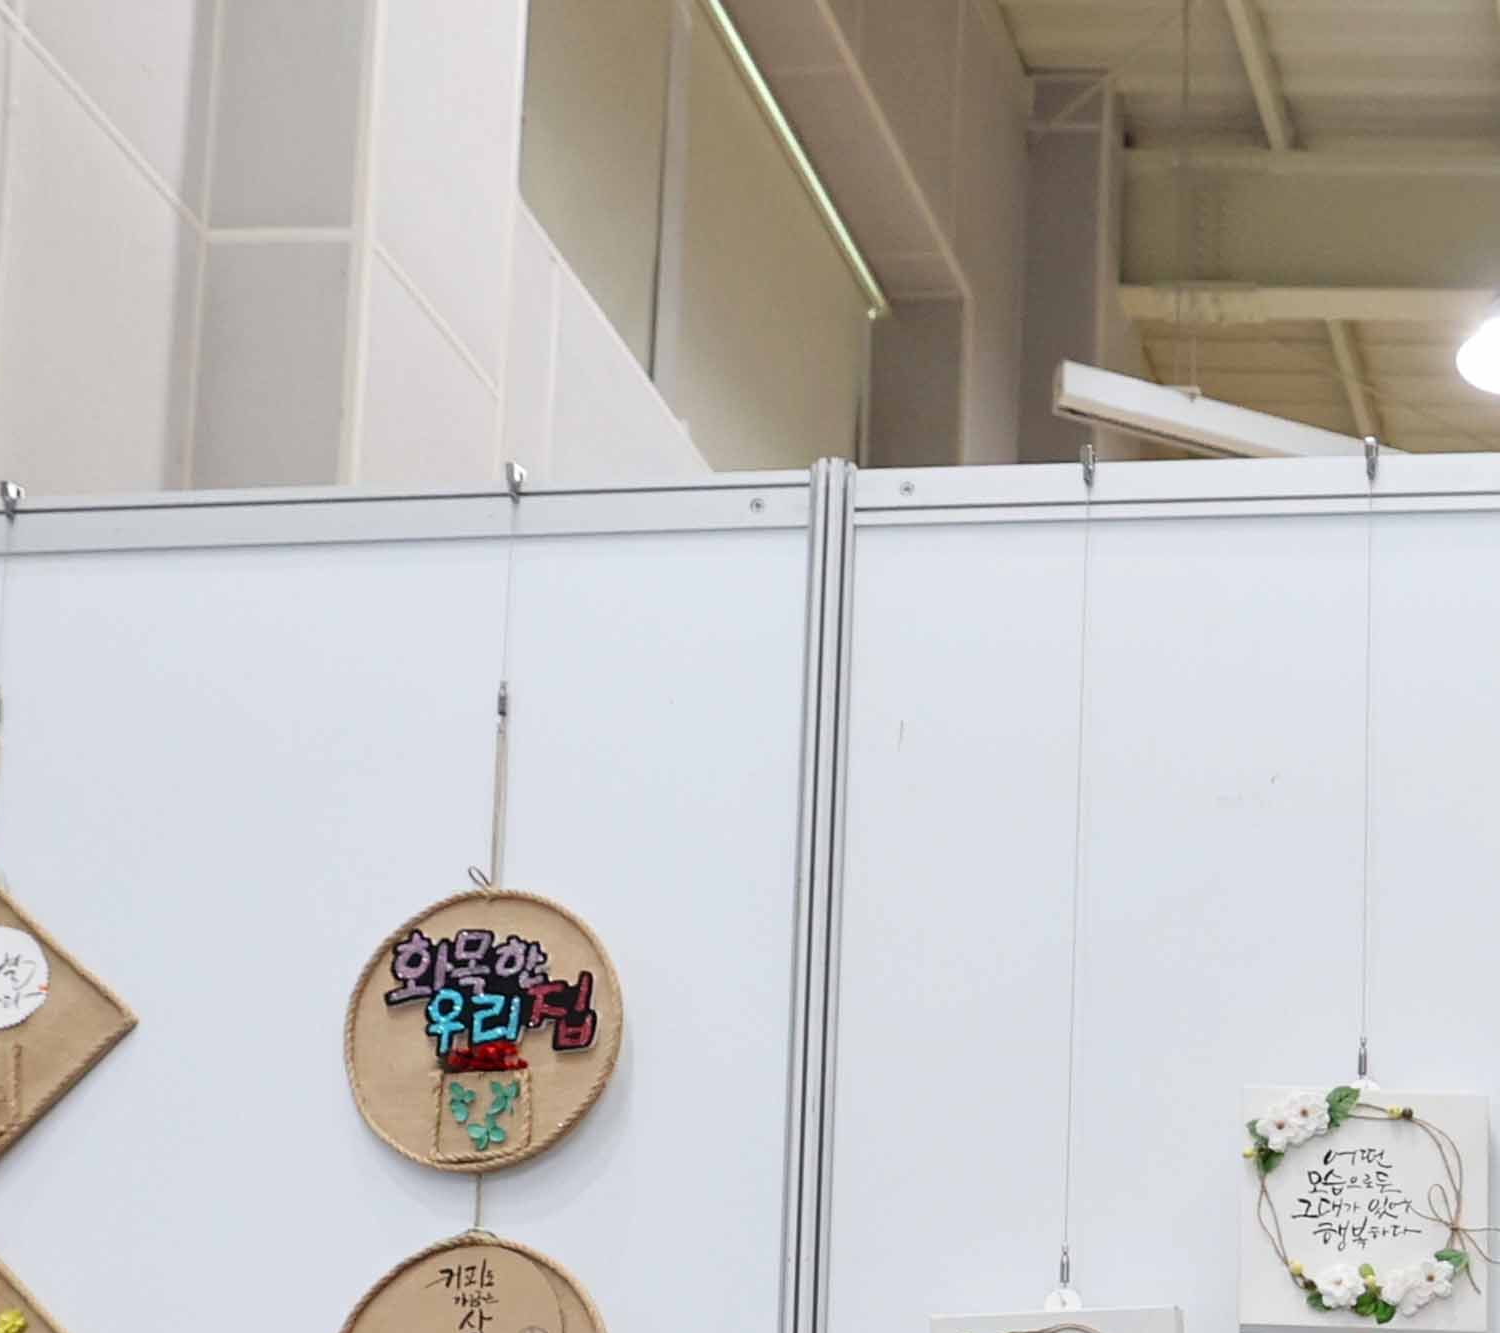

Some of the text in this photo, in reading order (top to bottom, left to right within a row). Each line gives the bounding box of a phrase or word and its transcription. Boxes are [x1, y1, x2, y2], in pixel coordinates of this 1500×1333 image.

[385, 928, 549, 1006] 화목한
[425, 970, 596, 1056] 우리 집
[1323, 1149, 1393, 1168] 어떤
[1292, 1196, 1412, 1219] 그대가 있어
[1312, 1216, 1422, 1251] 행복하다
